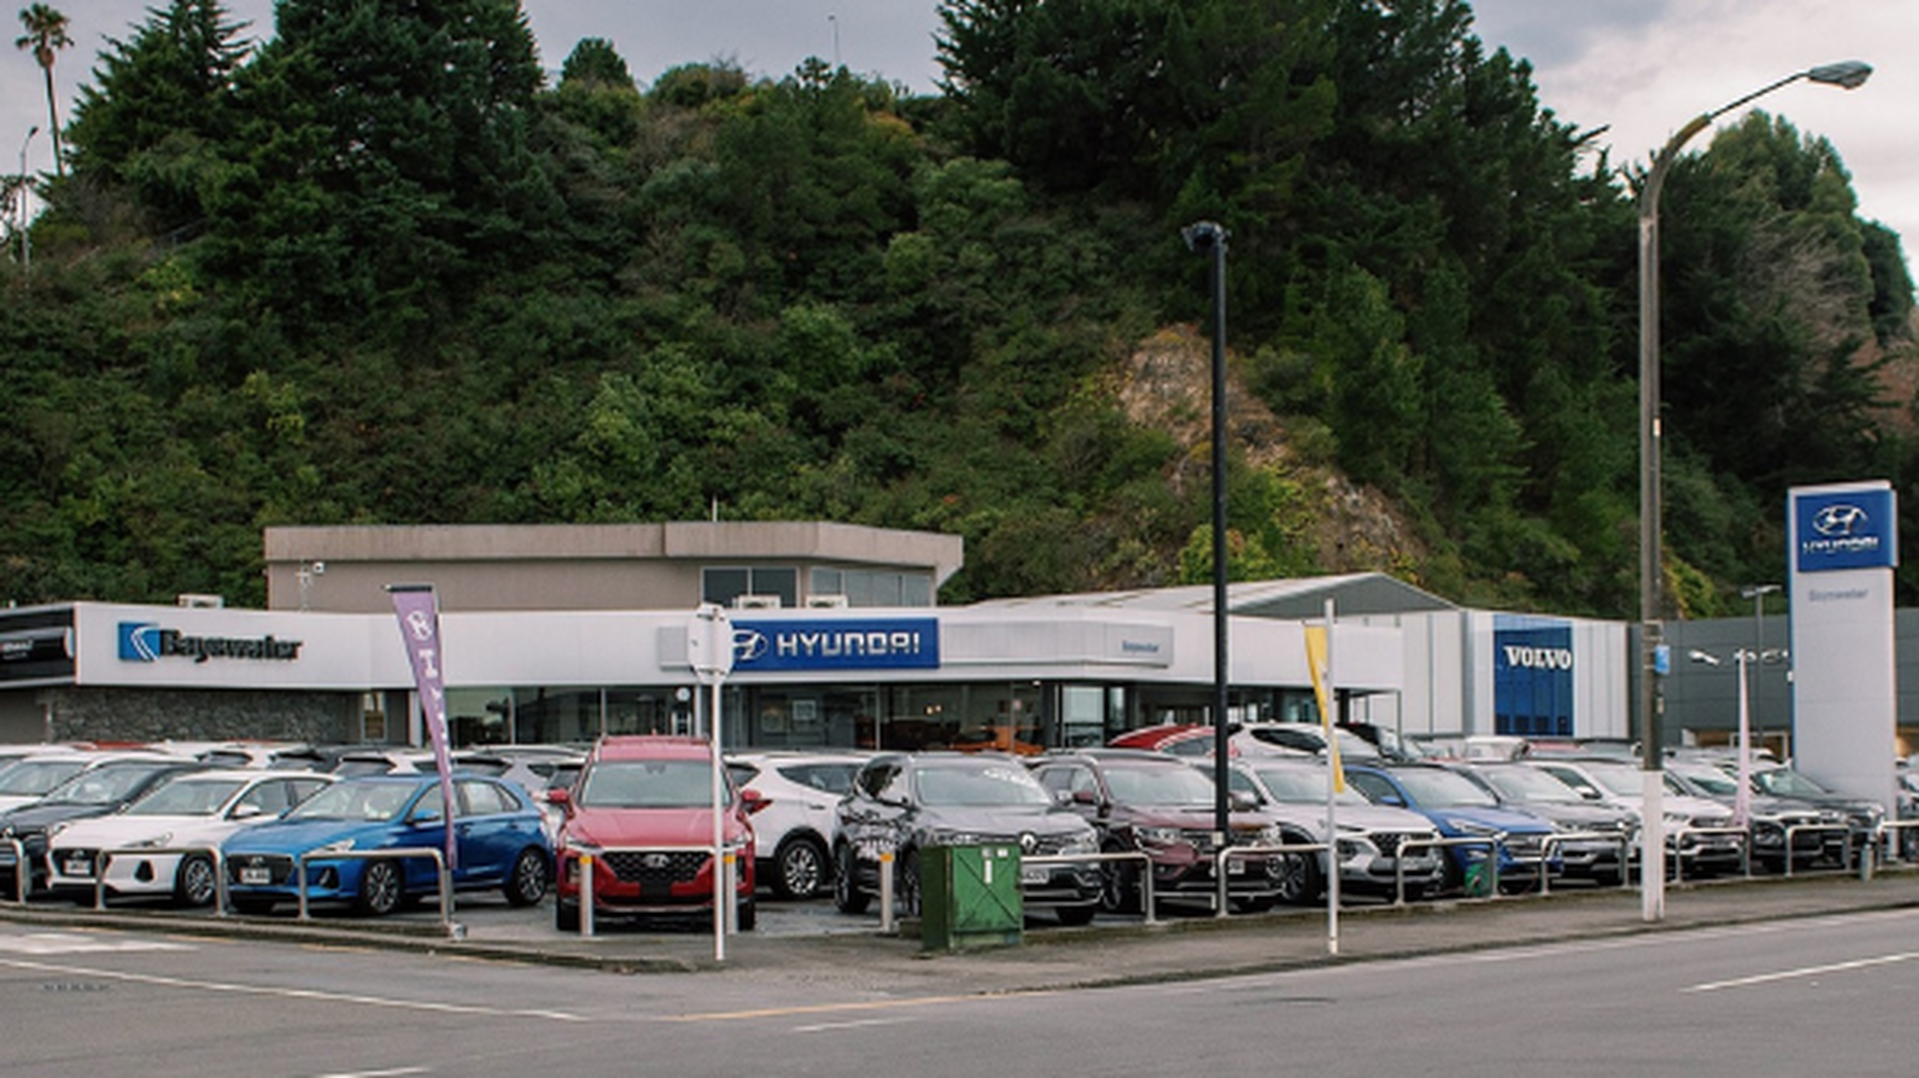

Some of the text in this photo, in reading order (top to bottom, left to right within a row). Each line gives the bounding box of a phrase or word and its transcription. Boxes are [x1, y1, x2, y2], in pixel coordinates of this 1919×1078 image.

[1802, 536, 1879, 554] HYUNDAI
[160, 629, 303, 664] Bayswater
[777, 631, 920, 657] HYUNDAI
[1503, 645, 1572, 670] VOLVO
